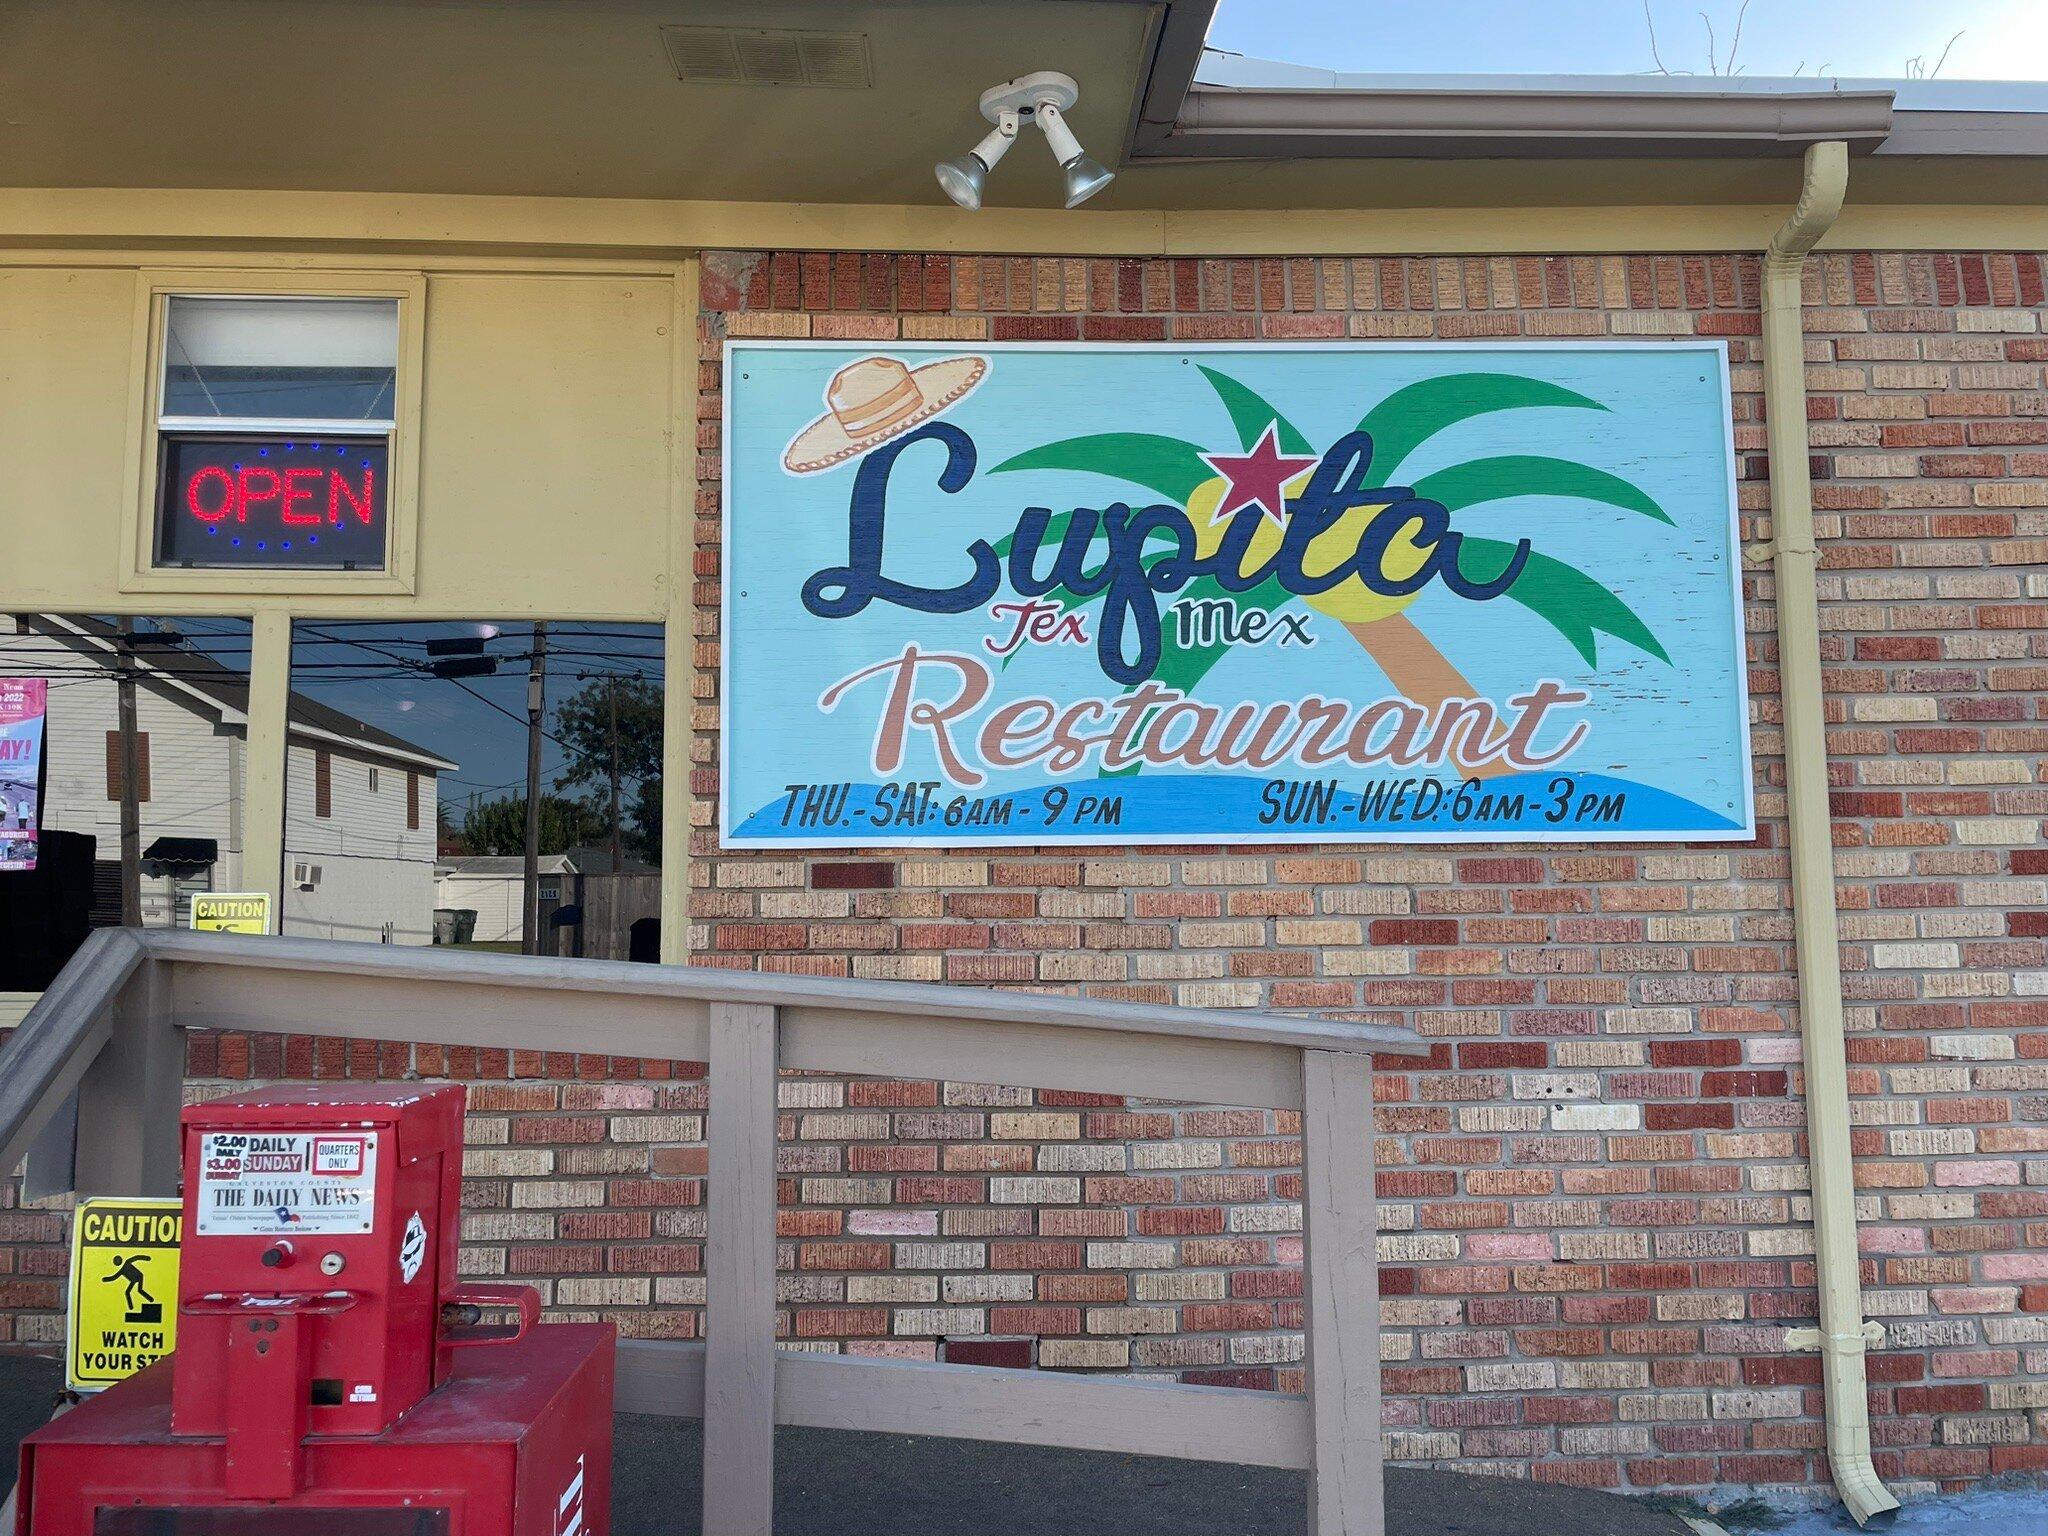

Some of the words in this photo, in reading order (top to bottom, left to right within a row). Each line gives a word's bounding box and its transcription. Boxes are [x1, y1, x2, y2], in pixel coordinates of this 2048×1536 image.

[187, 466, 374, 524] OPEN
[801, 421, 1531, 685] Lupita
[985, 599, 1090, 654] Tex
[1173, 600, 1316, 646] Mex
[4, 693, 24, 702] 2022
[818, 643, 1590, 785] Restaurant
[1072, 796, 1123, 826] PM
[197, 901, 264, 918] CAUTION
[213, 1134, 248, 1148] $2.00
[249, 1137, 297, 1153] DAILY
[216, 1148, 243, 1158] DAILY
[318, 1144, 360, 1156] QUARTERS
[206, 1157, 242, 1171] $3.00
[243, 1155, 301, 1171] SUNDAY
[328, 1157, 349, 1169] ONLY
[213, 1188, 246, 1207] THE
[253, 1188, 303, 1207] DAILY
[310, 1187, 360, 1206] NEWS
[102, 1331, 164, 1349] WATCH
[82, 1352, 132, 1371] YOUR
[136, 1353, 164, 1371] ST
